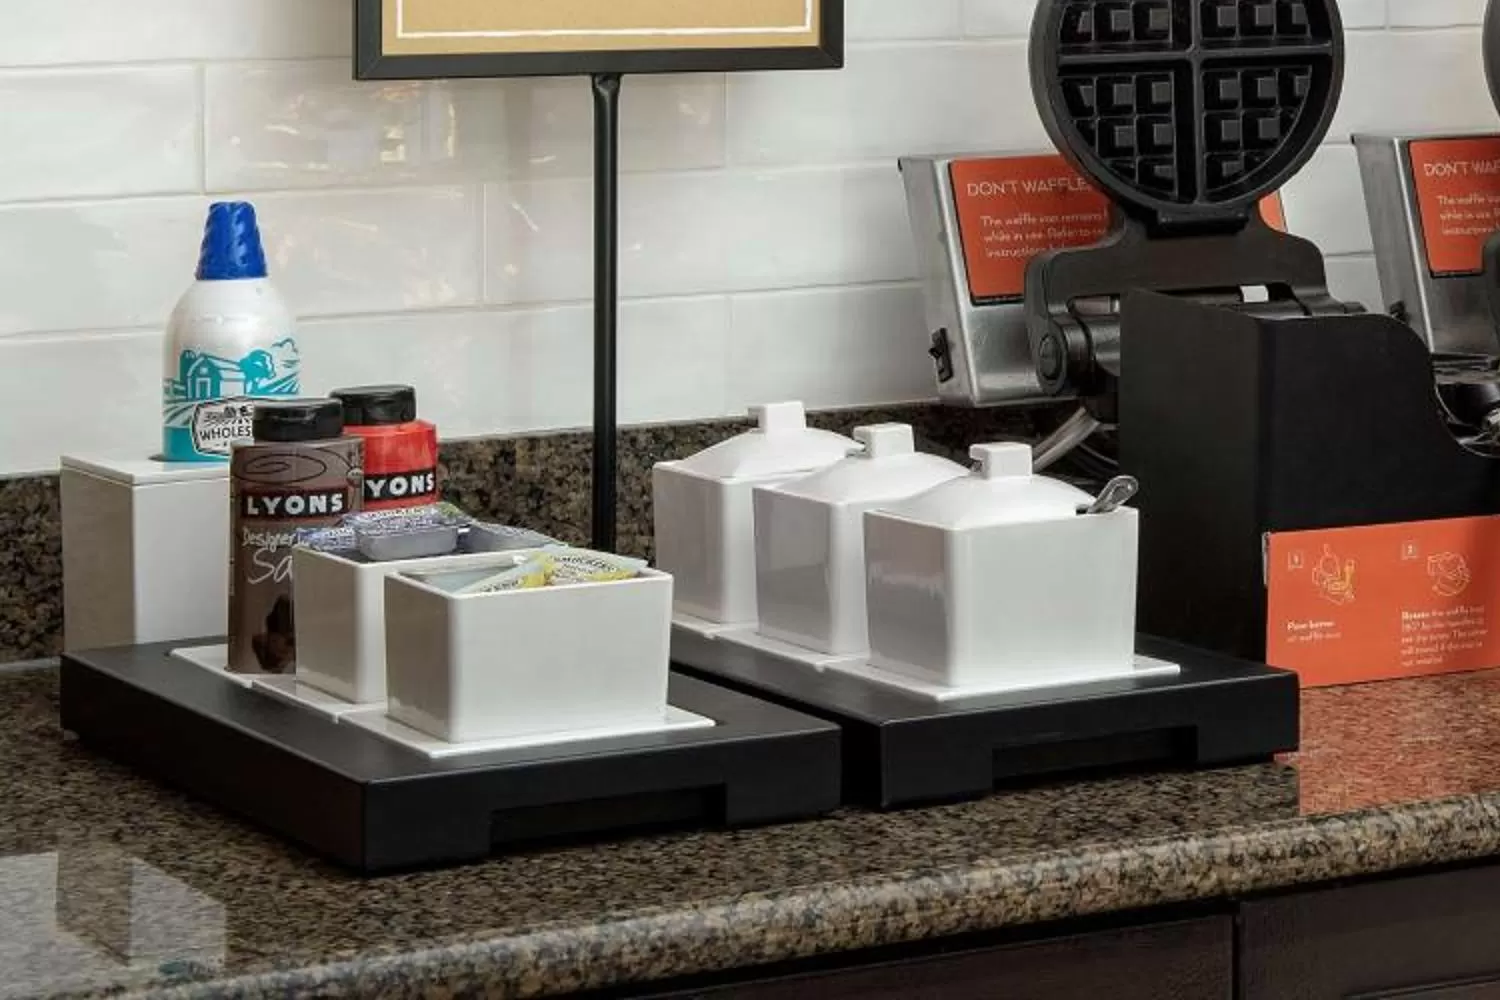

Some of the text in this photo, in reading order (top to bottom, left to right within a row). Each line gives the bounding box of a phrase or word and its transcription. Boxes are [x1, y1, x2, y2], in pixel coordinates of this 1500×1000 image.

[1423, 161, 1469, 177] DON'T
[967, 179, 1018, 197] DON'T
[200, 425, 252, 441] WHOLES
[364, 472, 435, 499] YONS
[246, 492, 344, 516] LYONS
[242, 525, 297, 553] Designer
[246, 547, 294, 585] Sa
